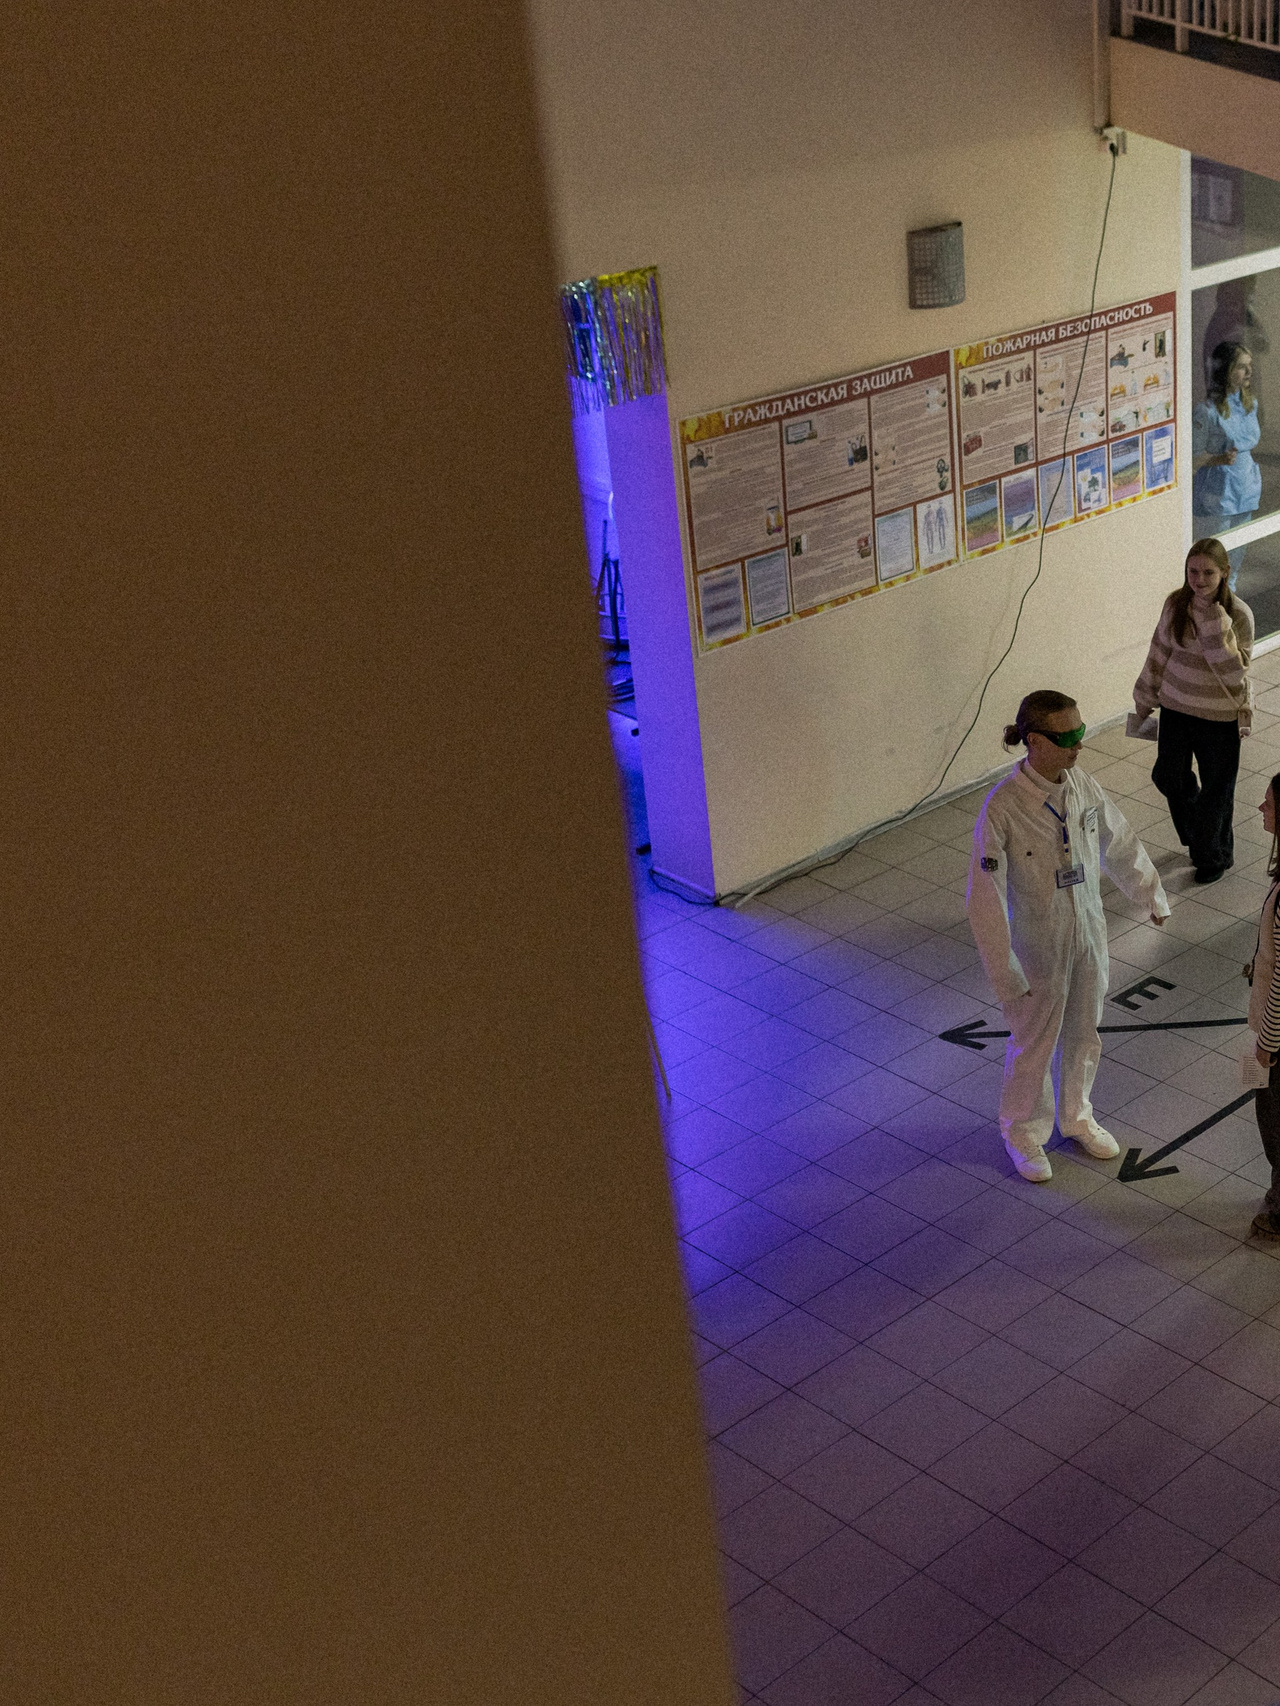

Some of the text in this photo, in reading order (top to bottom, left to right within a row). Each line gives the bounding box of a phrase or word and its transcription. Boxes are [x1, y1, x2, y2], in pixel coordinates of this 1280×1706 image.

[983, 301, 1154, 359] ПОЖАРНАЯ БЕЗОПАСНОСТЬ
[724, 364, 914, 429] ГРАЖДАНСКАЯ ЗАЩИТА
